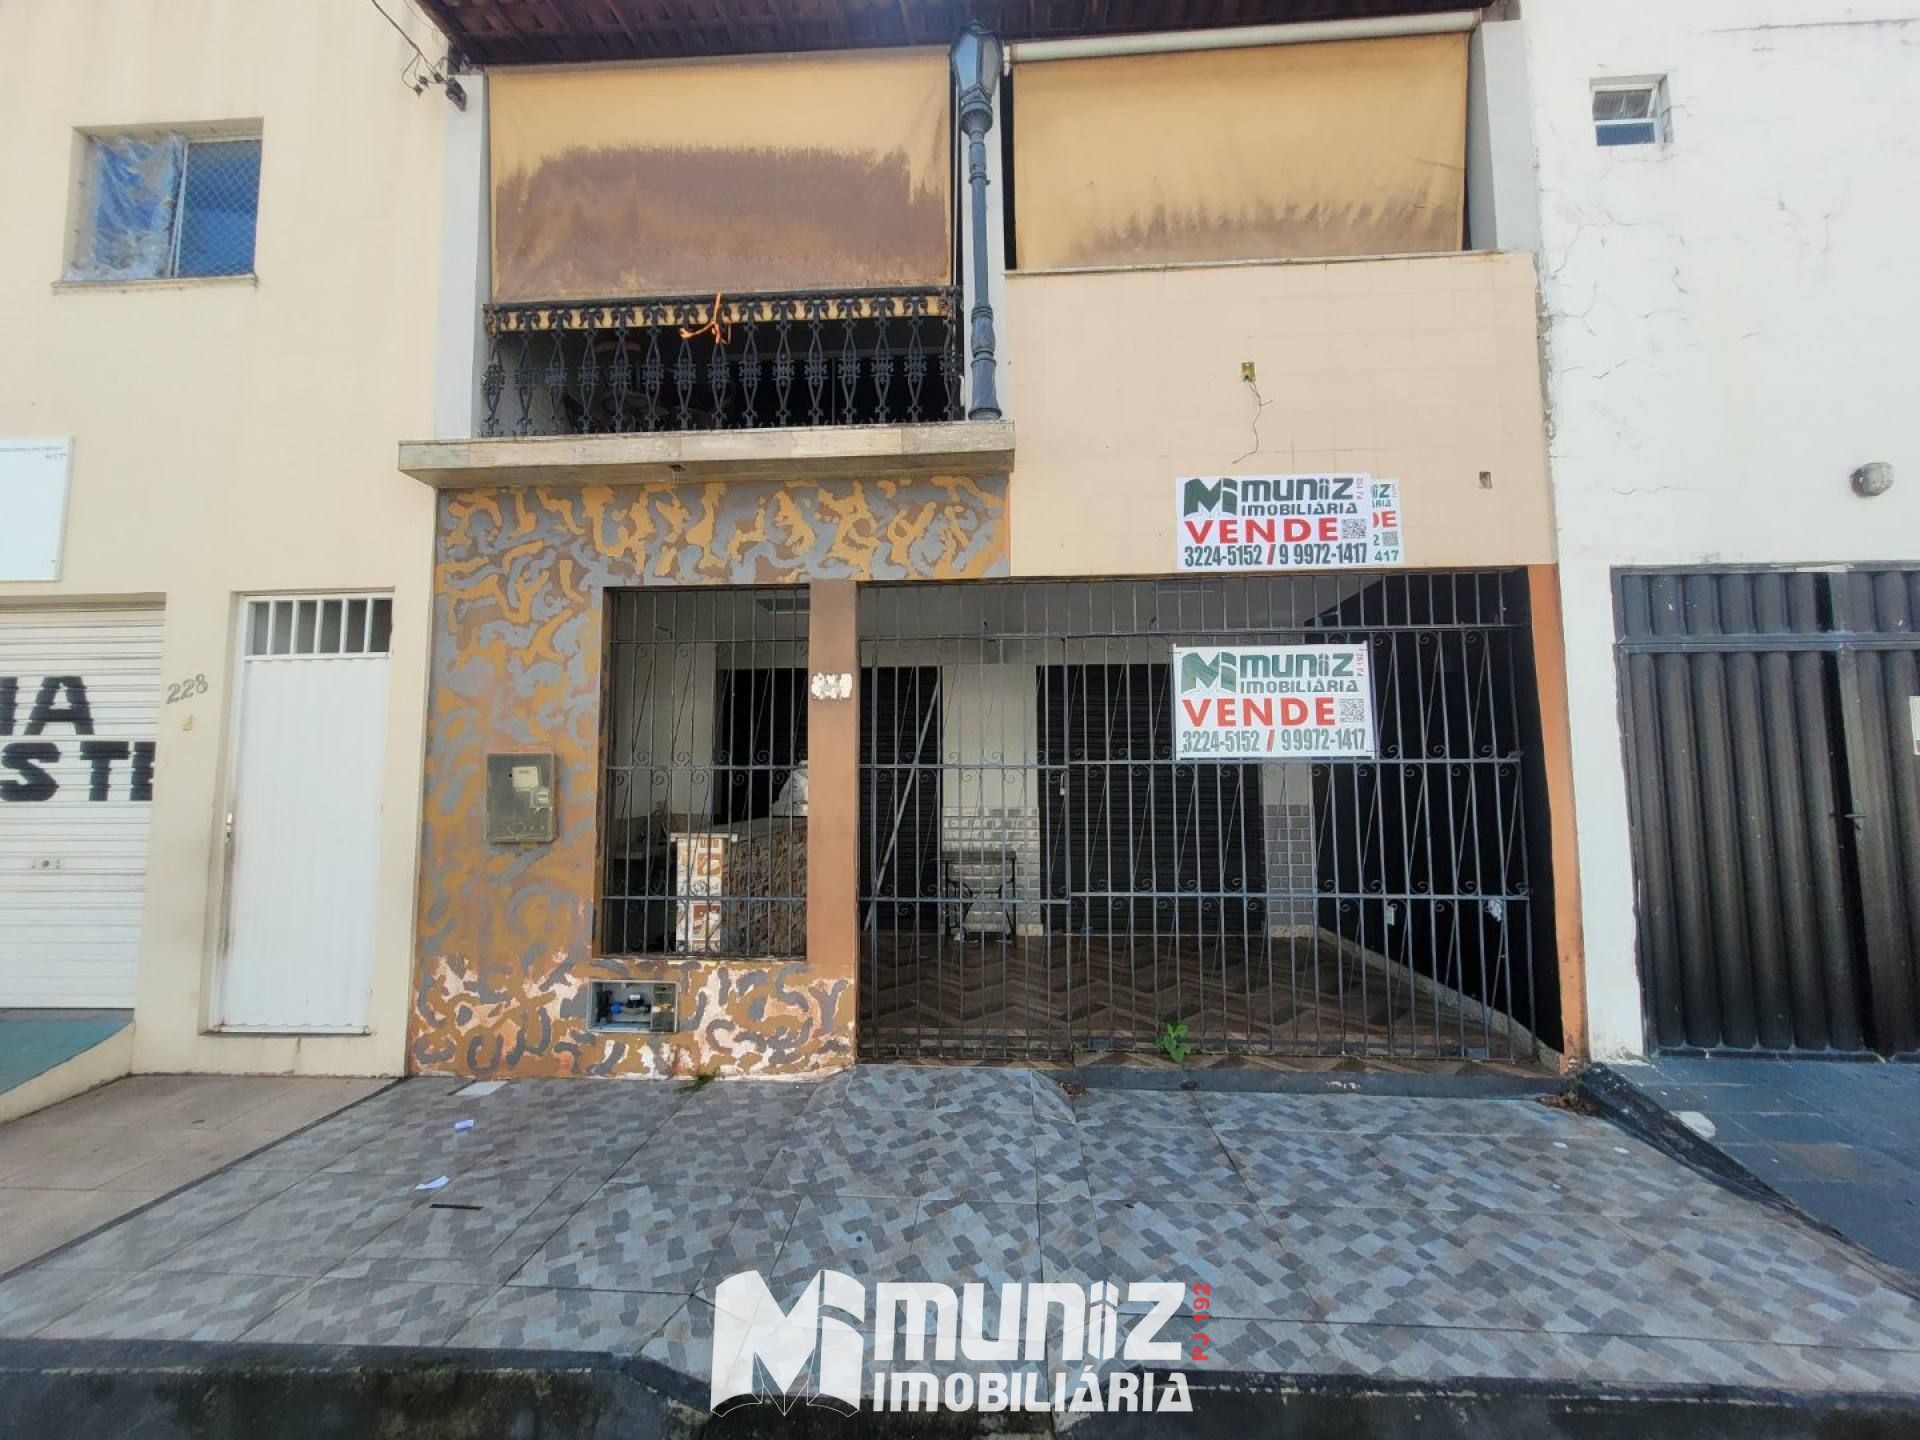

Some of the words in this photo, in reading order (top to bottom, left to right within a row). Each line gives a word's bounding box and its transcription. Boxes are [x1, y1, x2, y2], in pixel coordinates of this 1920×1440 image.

[1184, 517, 1338, 544] VENDE
[1184, 544, 1262, 567] 3224-5152
[166, 673, 209, 704] 228
[1182, 697, 1336, 727] VENDE
[1183, 730, 1260, 752] 3224-5152
